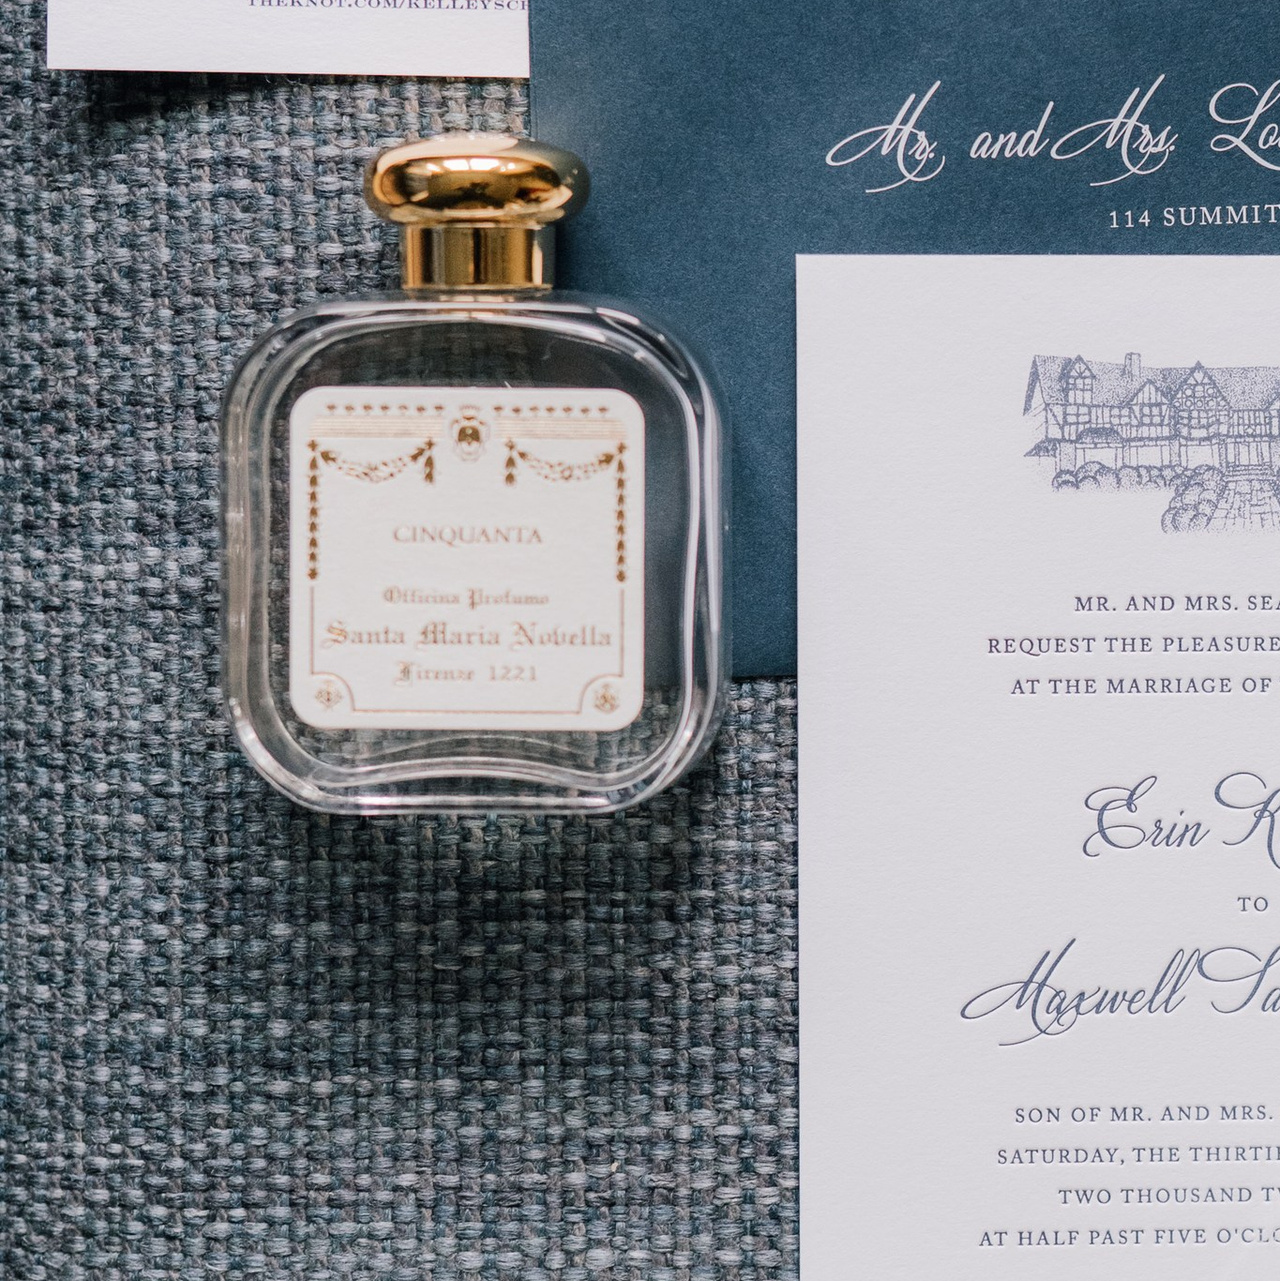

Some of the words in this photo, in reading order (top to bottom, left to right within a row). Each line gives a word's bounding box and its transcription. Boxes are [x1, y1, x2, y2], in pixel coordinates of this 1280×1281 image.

[825, 80, 946, 194] Mr.
[968, 100, 1055, 160] and
[1050, 73, 1179, 187] Mrs.
[1109, 209, 1151, 229] 114
[392, 525, 543, 548] CINQUANTA
[381, 585, 461, 605] Officina
[467, 587, 550, 611] Profumo
[1074, 596, 1117, 612] MR.
[1124, 595, 1175, 612] AND
[1184, 594, 1239, 611] MRS.
[322, 619, 406, 645] Santa
[416, 621, 501, 646] Maria
[513, 621, 612, 647] Novella
[987, 636, 1097, 657] REQUEST
[1103, 636, 1153, 653] THE
[394, 660, 475, 683] Firenze
[489, 664, 537, 682] 1221
[1010, 678, 1041, 695] AT
[1047, 678, 1097, 695] THE
[1106, 677, 1232, 694] MARRIAGE
[1241, 677, 1272, 693] OF
[1082, 774, 1211, 859] Erin
[1236, 896, 1269, 912] TO
[959, 937, 1200, 1047] Maxwell
[1015, 1107, 1061, 1124] SON
[1070, 1106, 1102, 1123] OF
[1110, 1106, 1152, 1122] MR.
[1160, 1105, 1210, 1122] AND
[1219, 1104, 1273, 1121] MRS.
[997, 1147, 1125, 1166] SATURDAY,
[1131, 1146, 1181, 1163] THE
[1057, 1188, 1112, 1205] TWO
[1119, 1187, 1253, 1204] THOUSAND
[978, 1230, 1008, 1247] AT
[1017, 1230, 1080, 1246] HALF
[1088, 1228, 1145, 1245] PAST
[1154, 1228, 1207, 1245] FIVE
